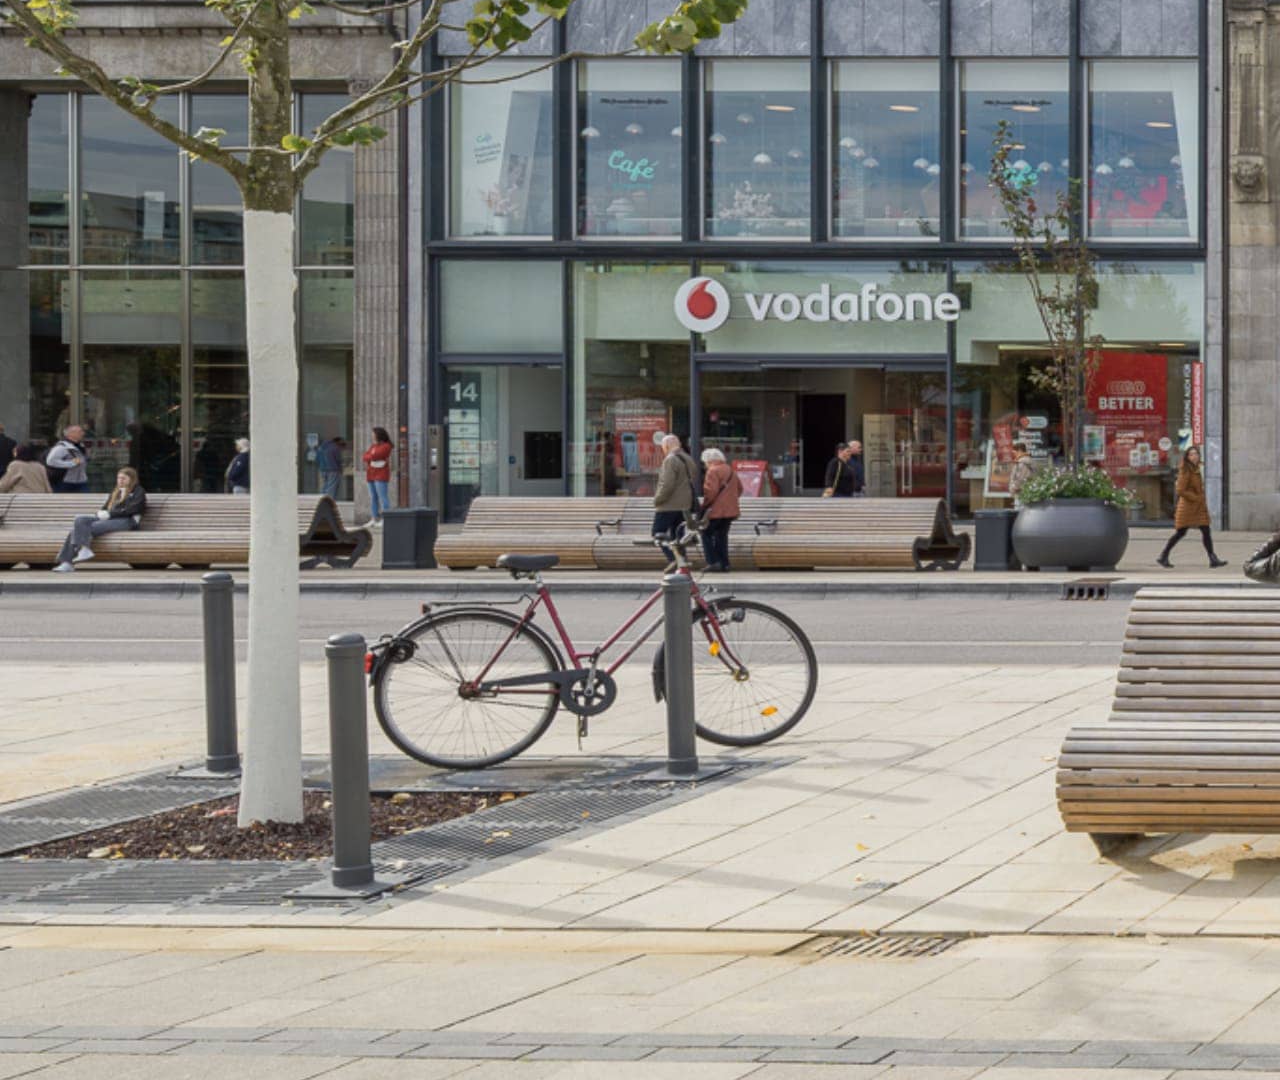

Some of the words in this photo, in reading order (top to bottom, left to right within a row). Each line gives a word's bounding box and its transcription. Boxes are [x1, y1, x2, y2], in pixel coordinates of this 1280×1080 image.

[607, 149, 659, 182] Café
[744, 283, 961, 322] vodafone
[449, 381, 479, 402] 14
[1098, 396, 1154, 411] BETTER
